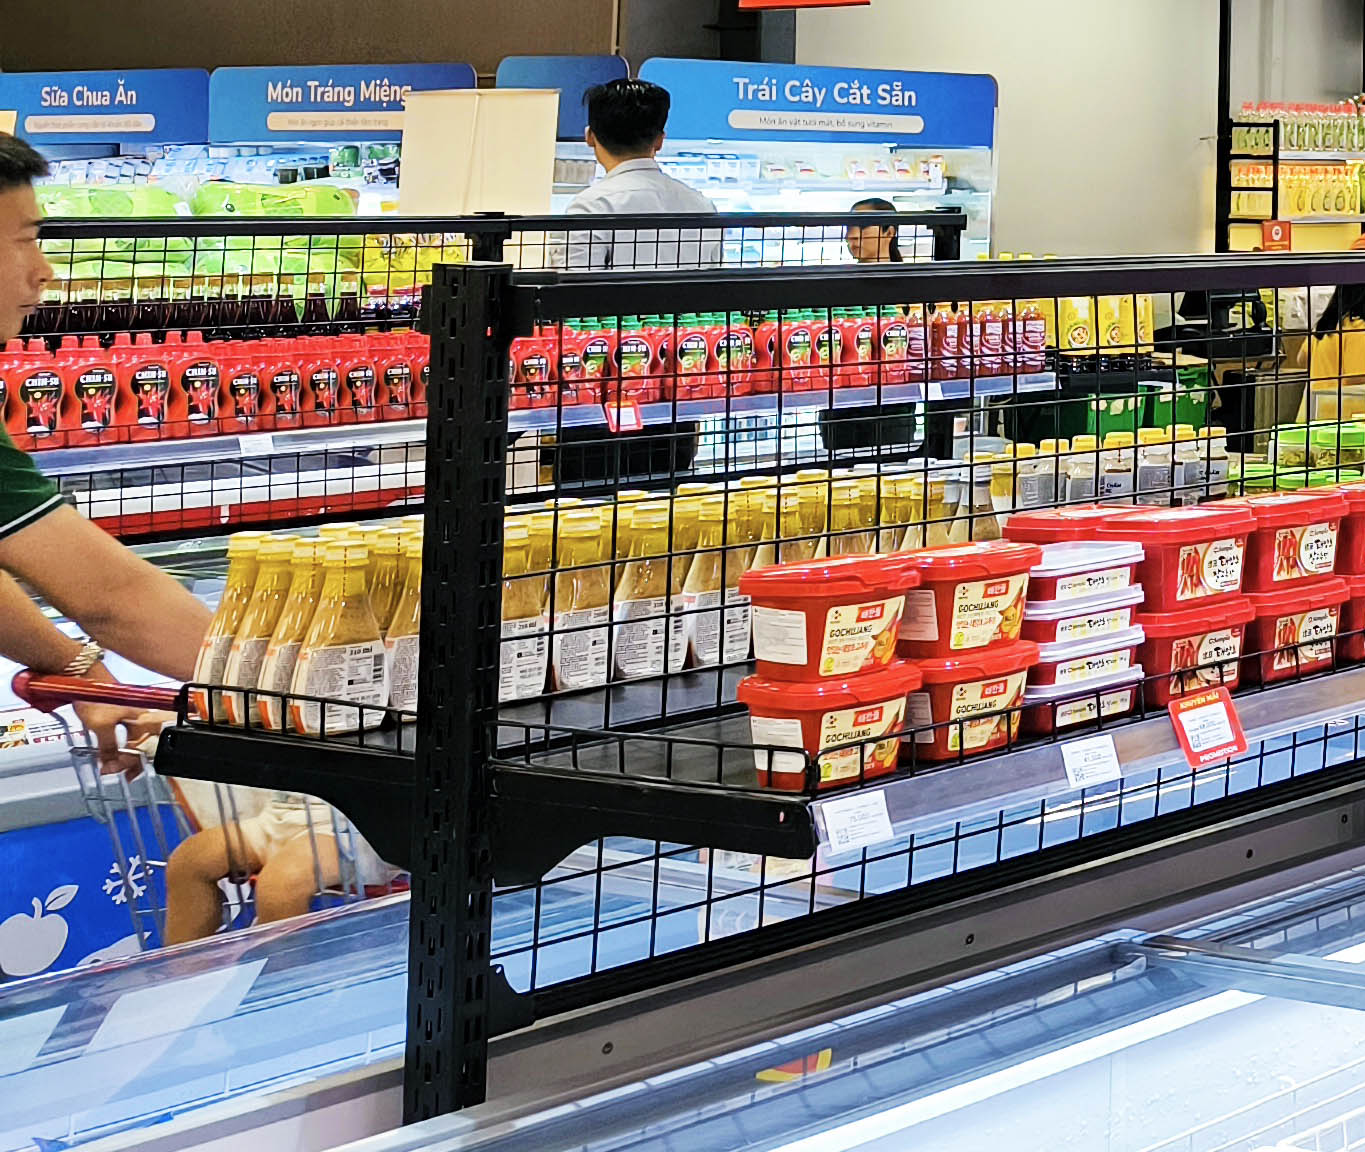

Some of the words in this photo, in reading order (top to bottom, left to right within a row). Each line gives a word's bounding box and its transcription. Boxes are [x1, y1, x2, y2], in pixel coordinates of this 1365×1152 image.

[41, 82, 69, 107] Sữa
[72, 84, 110, 107] Chua
[114, 79, 137, 105] Ăn
[267, 80, 303, 104] Món
[306, 79, 355, 107] Tráng
[732, 77, 778, 102] Trái
[784, 78, 826, 108] Cây
[833, 79, 871, 105] Cắt
[877, 79, 917, 107] Sẵn
[25, 376, 59, 388] CHIN-SU
[829, 624, 873, 638] GOCHUJANG
[825, 728, 871, 743] GOCHUJANG
